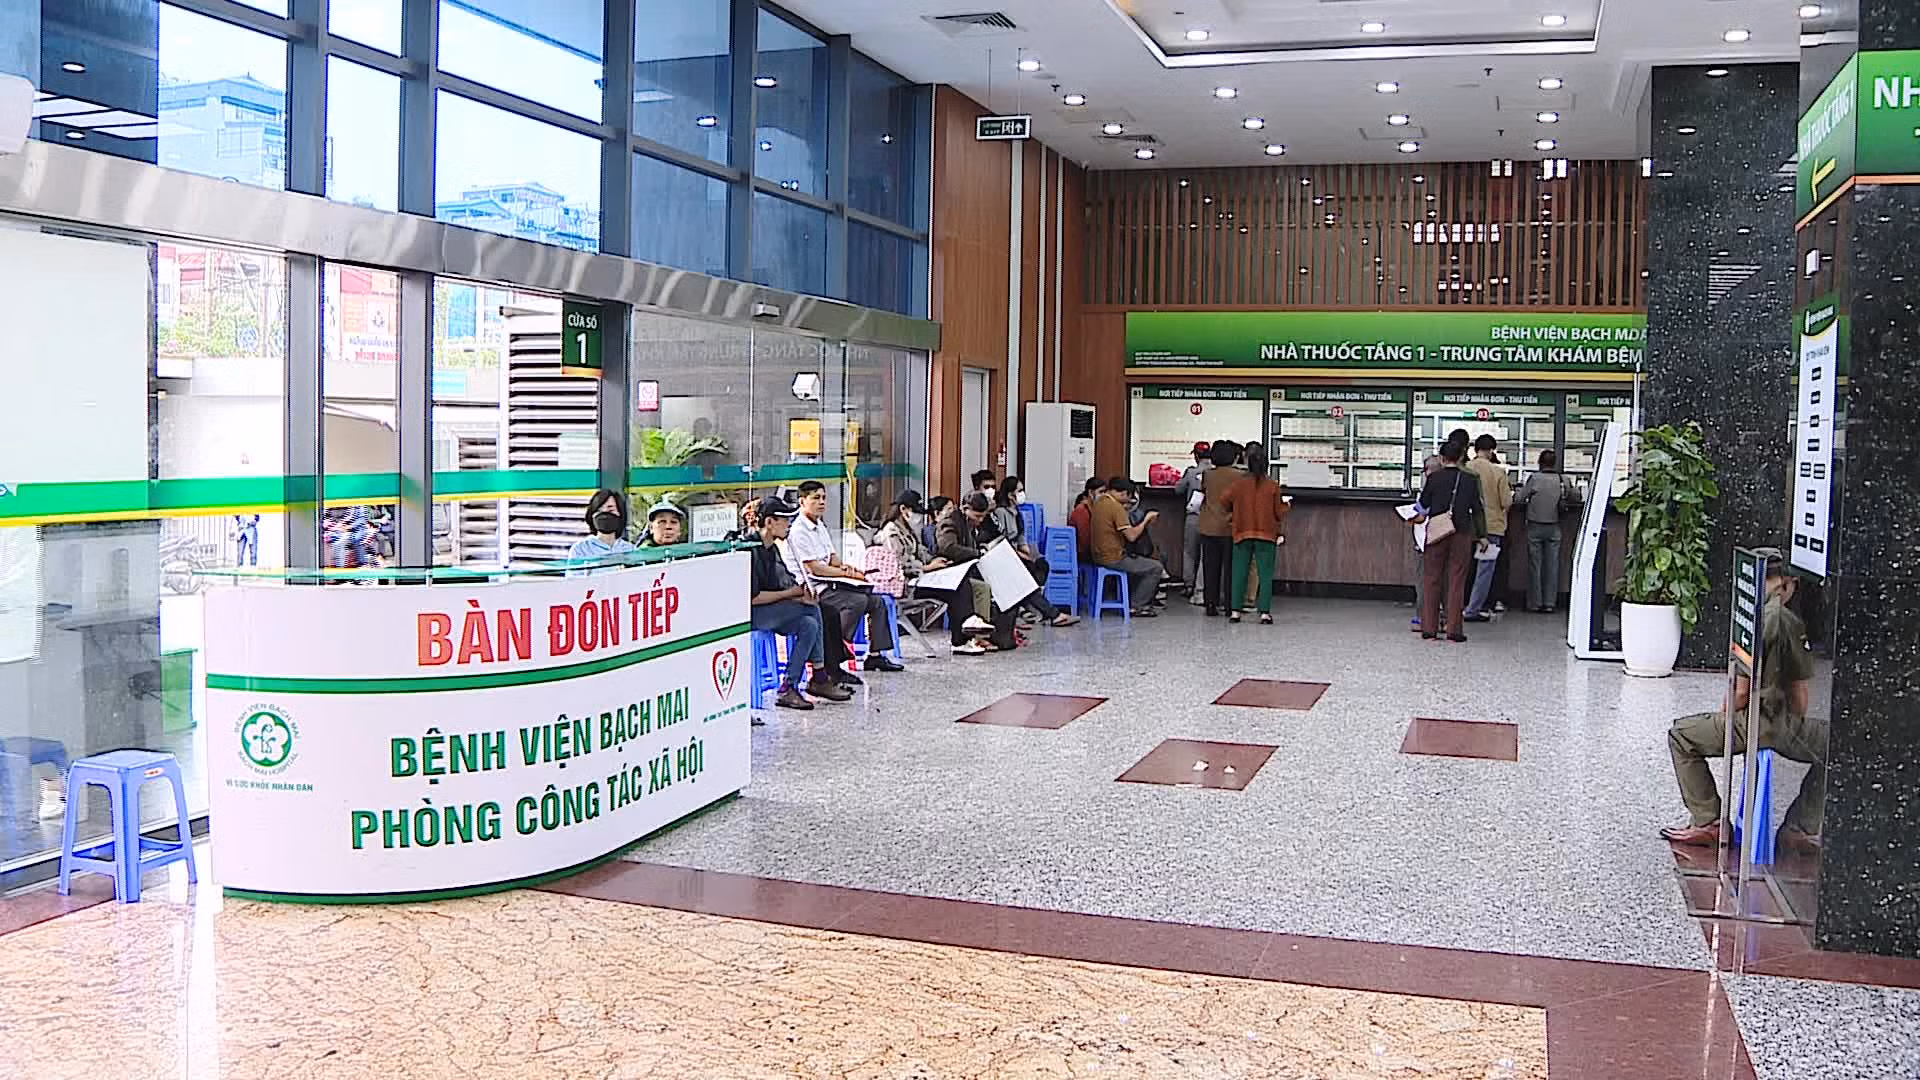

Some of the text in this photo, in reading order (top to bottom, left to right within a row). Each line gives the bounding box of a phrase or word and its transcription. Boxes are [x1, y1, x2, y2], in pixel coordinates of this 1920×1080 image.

[568, 312, 585, 328] CỬA
[1491, 325, 1531, 342] BỆNH
[1534, 325, 1568, 343] VIỆN
[1571, 327, 1612, 343] BẠCH
[576, 333, 587, 364] 1
[1260, 341, 1298, 359] NHÀ
[1300, 341, 1362, 360] THUỐC
[1416, 345, 1425, 361] 1
[1439, 346, 1502, 362] TRUNG
[1504, 344, 1543, 362] TÂM
[1547, 345, 1602, 363] KHÁM
[417, 572, 679, 666] BÀN ĐÓN TIẾP
[391, 686, 690, 785] BỆNH VIỆN BẠCH MAI
[350, 736, 704, 850] PHÒNG CÔNG TÁC XÃ HỘI
